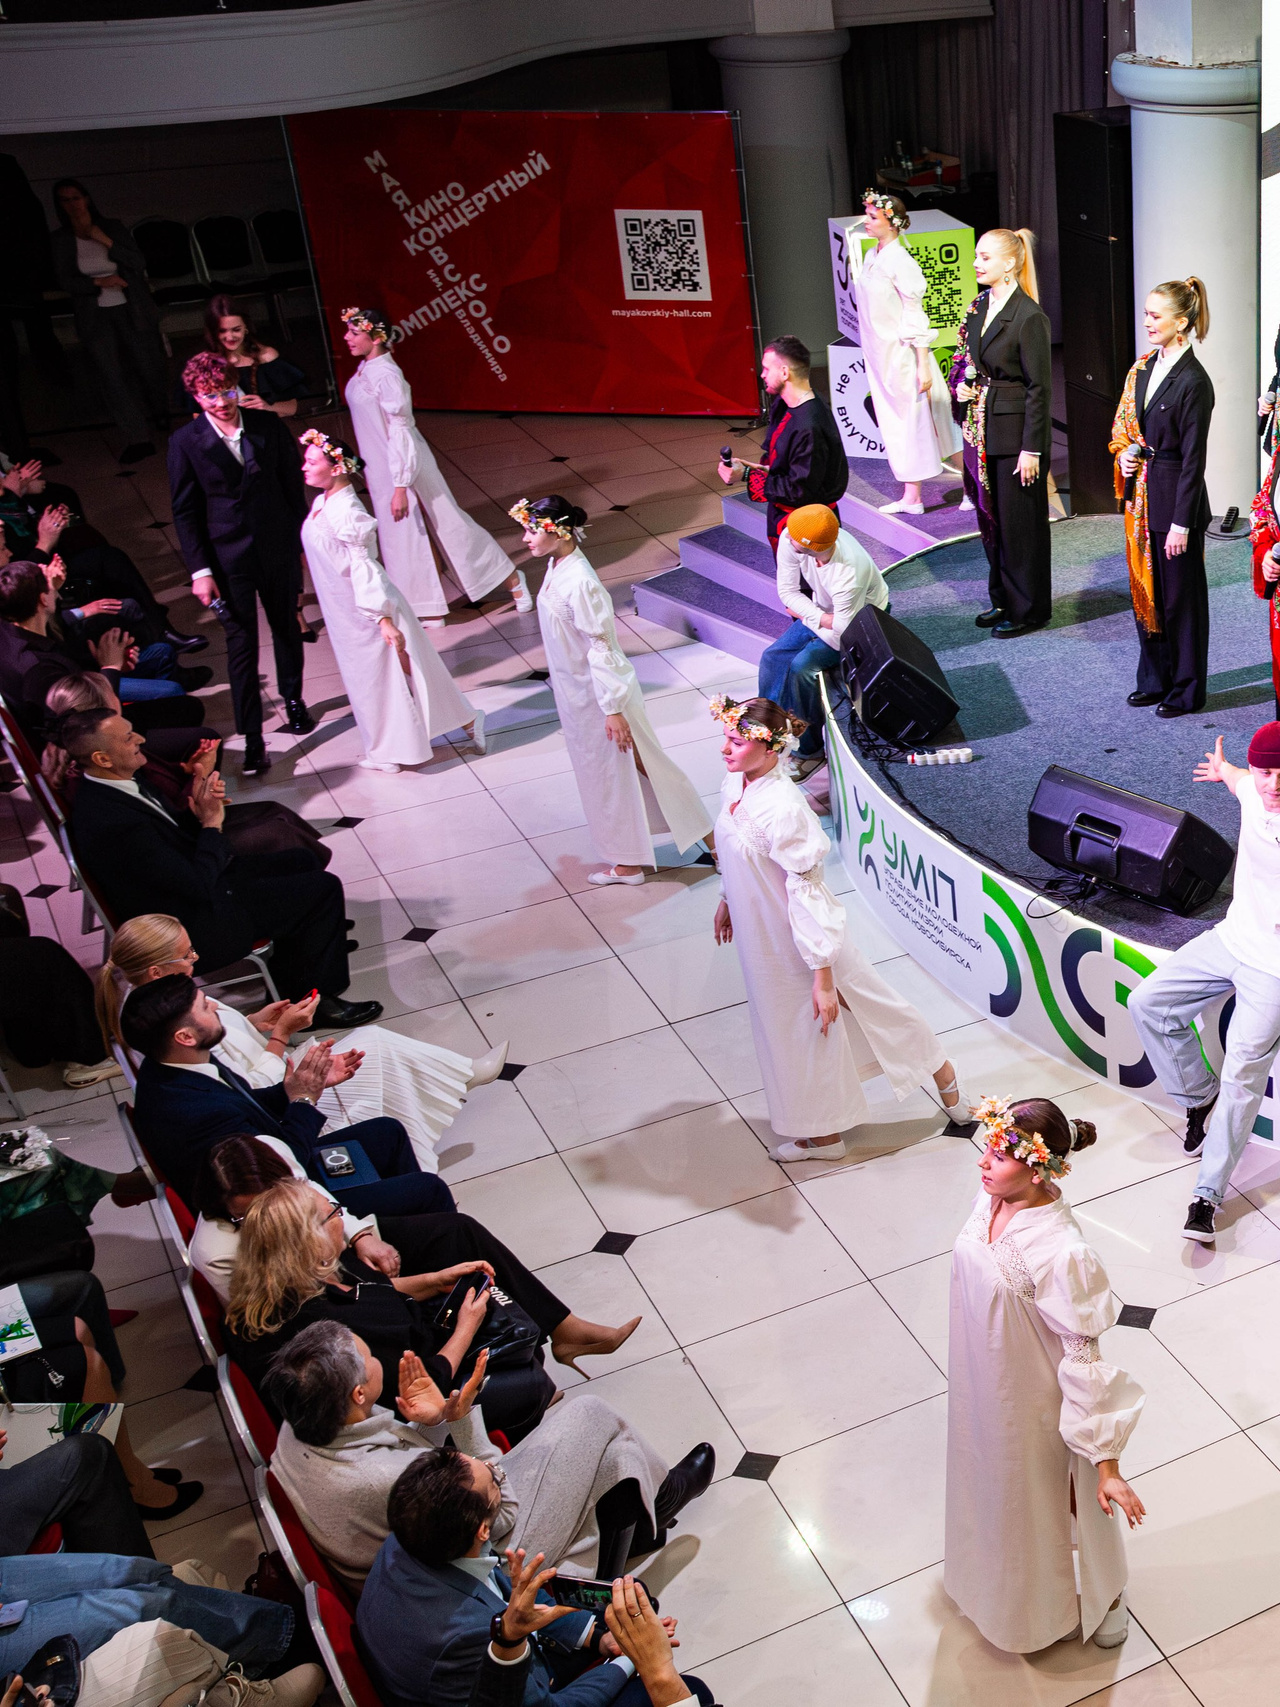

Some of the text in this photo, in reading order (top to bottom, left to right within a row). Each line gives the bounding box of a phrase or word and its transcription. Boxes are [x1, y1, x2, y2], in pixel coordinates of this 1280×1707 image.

[402, 150, 551, 256] КОНЦЕРТНЫЙ
[403, 182, 465, 229] КИНО
[390, 273, 488, 343] ОМПЛЕКС
[611, 308, 712, 319] mayakovskiy-hall.com
[835, 373, 850, 394] не
